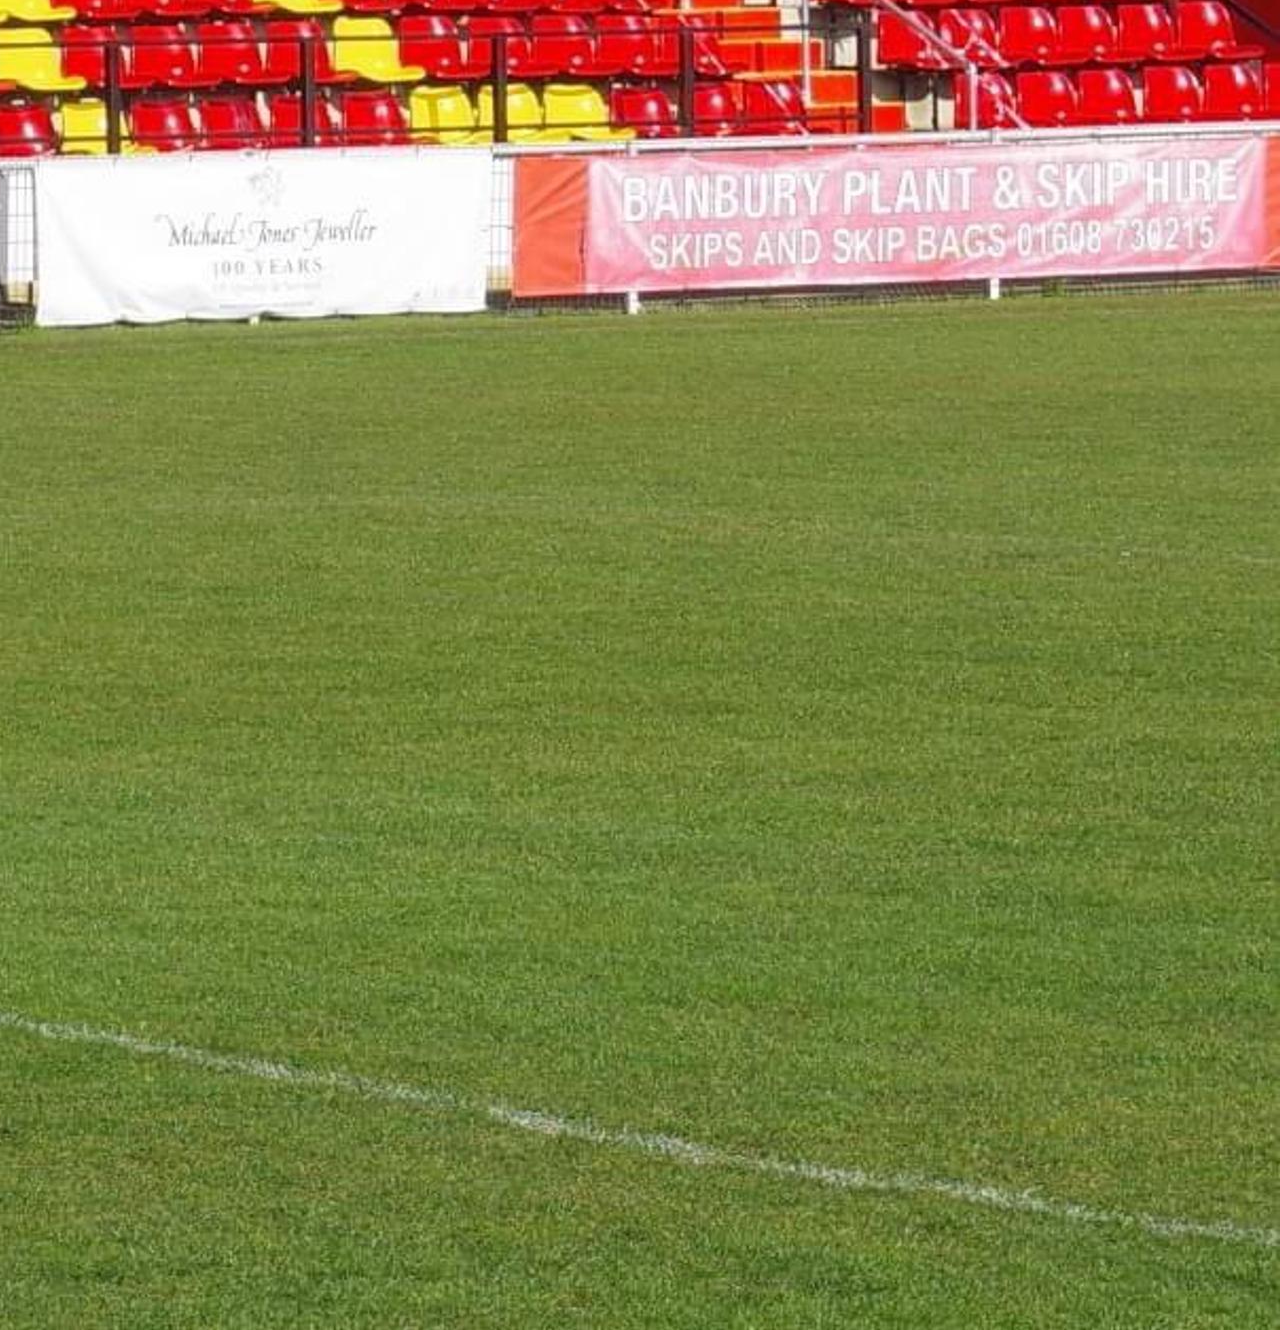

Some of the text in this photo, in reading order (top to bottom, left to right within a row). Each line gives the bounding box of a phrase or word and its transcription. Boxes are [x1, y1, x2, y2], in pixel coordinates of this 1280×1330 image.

[623, 157, 1239, 223] BANBURY PLANT & SKIP HIRE
[153, 208, 378, 253] Michael Jones Jeweller
[649, 215, 1215, 270] SKIPS AND SKIP BAGS 01608 730215
[213, 256, 323, 280] 100 YEARS
